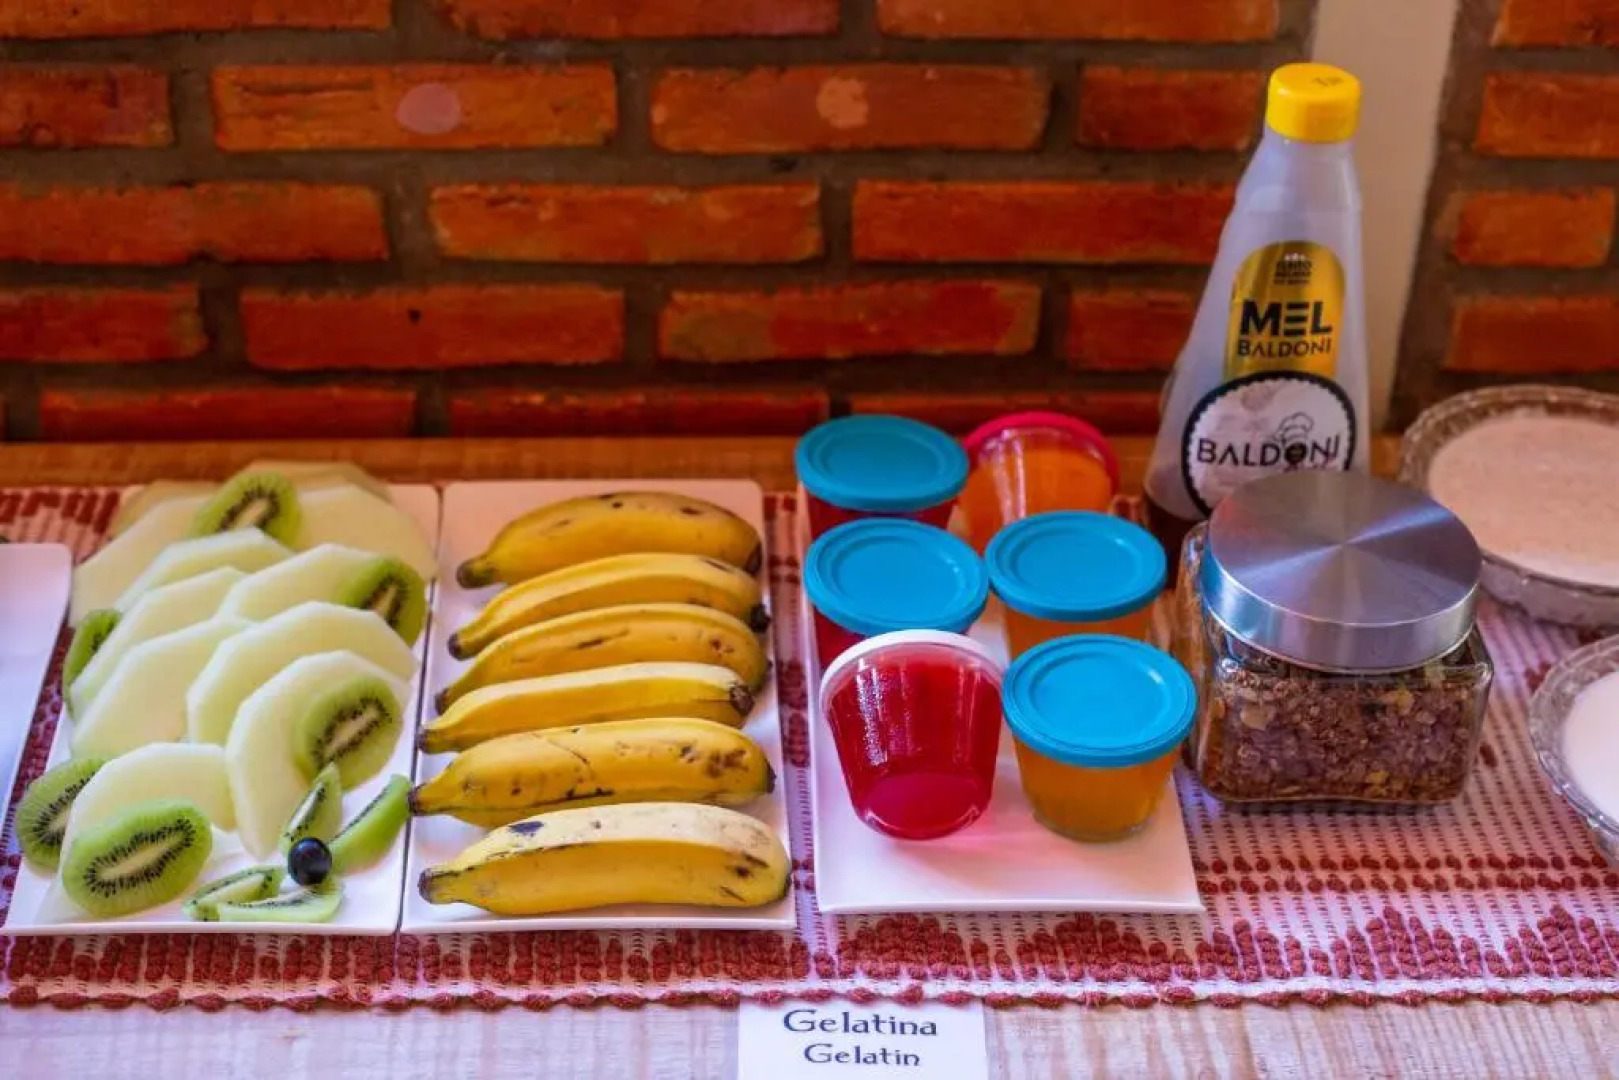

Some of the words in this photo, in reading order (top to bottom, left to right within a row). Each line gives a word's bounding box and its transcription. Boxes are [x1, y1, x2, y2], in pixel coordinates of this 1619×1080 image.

[1240, 300, 1333, 336] MEL
[1237, 338, 1332, 358] BALDONI
[1196, 435, 1340, 467] BALDONI
[782, 1008, 938, 1036] Gelatina
[803, 1043, 921, 1067] Gelatin
